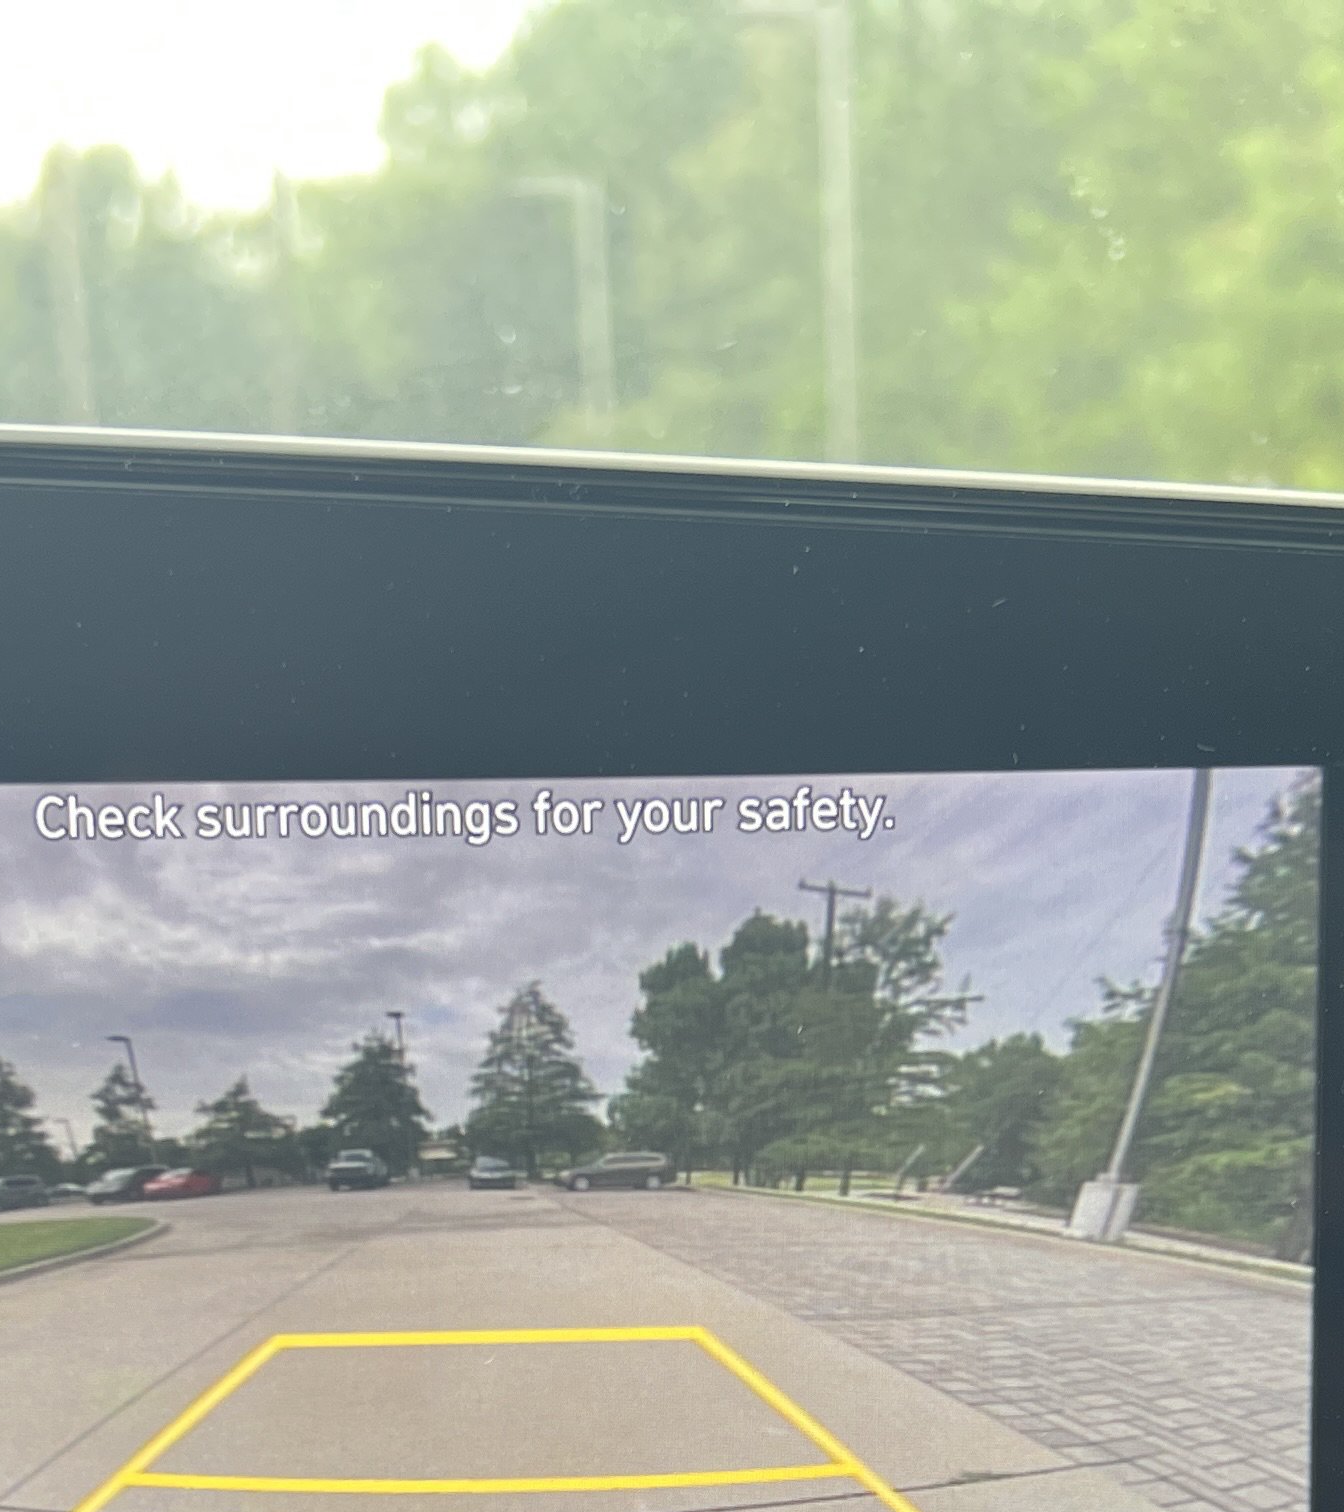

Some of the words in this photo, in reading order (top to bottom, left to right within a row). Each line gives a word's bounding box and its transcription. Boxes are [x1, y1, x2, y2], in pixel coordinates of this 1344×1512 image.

[35, 793, 183, 841] Check
[196, 789, 519, 846] surroundings
[533, 790, 603, 836] for
[617, 796, 724, 845] your
[737, 785, 896, 840] safety.
